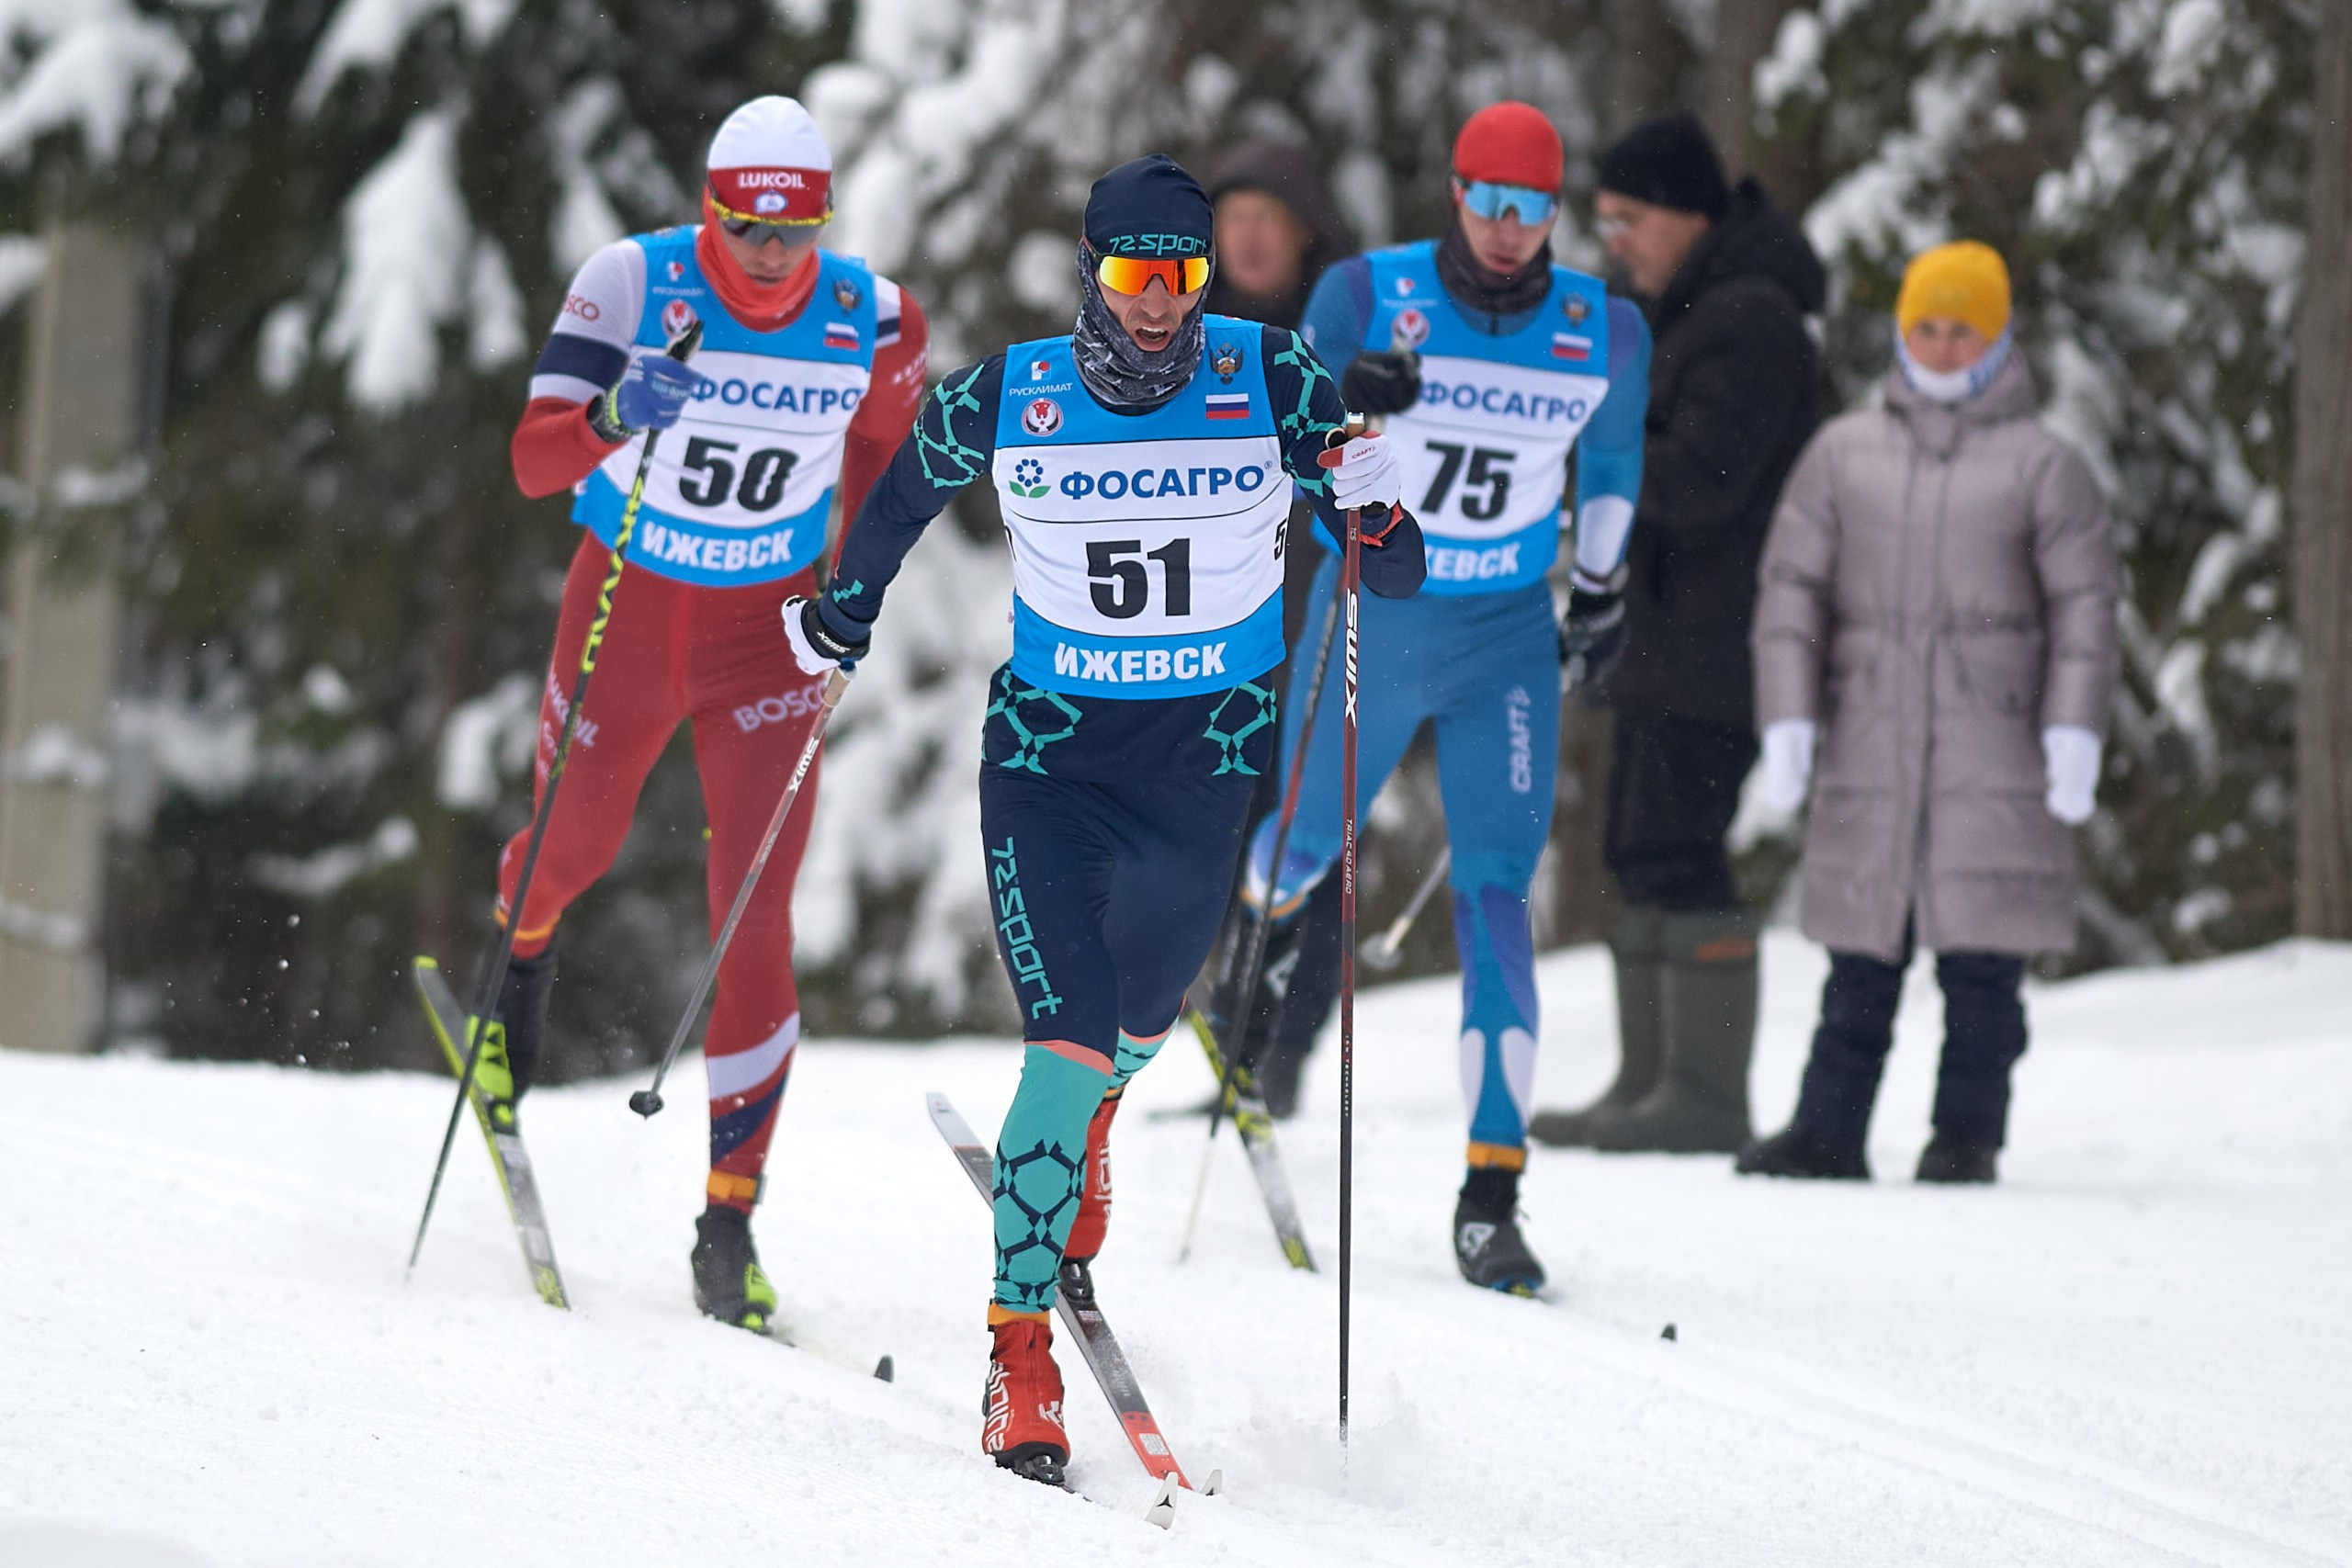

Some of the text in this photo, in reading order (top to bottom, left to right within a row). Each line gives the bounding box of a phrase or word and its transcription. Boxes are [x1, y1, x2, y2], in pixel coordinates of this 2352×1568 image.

[739, 172, 806, 189] LUKOIL
[691, 378, 864, 414] ФОСАГРО
[1009, 382, 1073, 397] РУСКЛИМАТ
[1421, 381, 1587, 422] ФОСАГРО
[679, 434, 801, 513] 50
[1059, 465, 1265, 500] ФОСАГРО
[1420, 439, 1518, 522] 75
[641, 520, 795, 572] ИЖЕВСК
[1425, 542, 1521, 581] ЕВСК
[1085, 537, 1191, 619] 51
[1054, 641, 1227, 683] ИЖЕВСК
